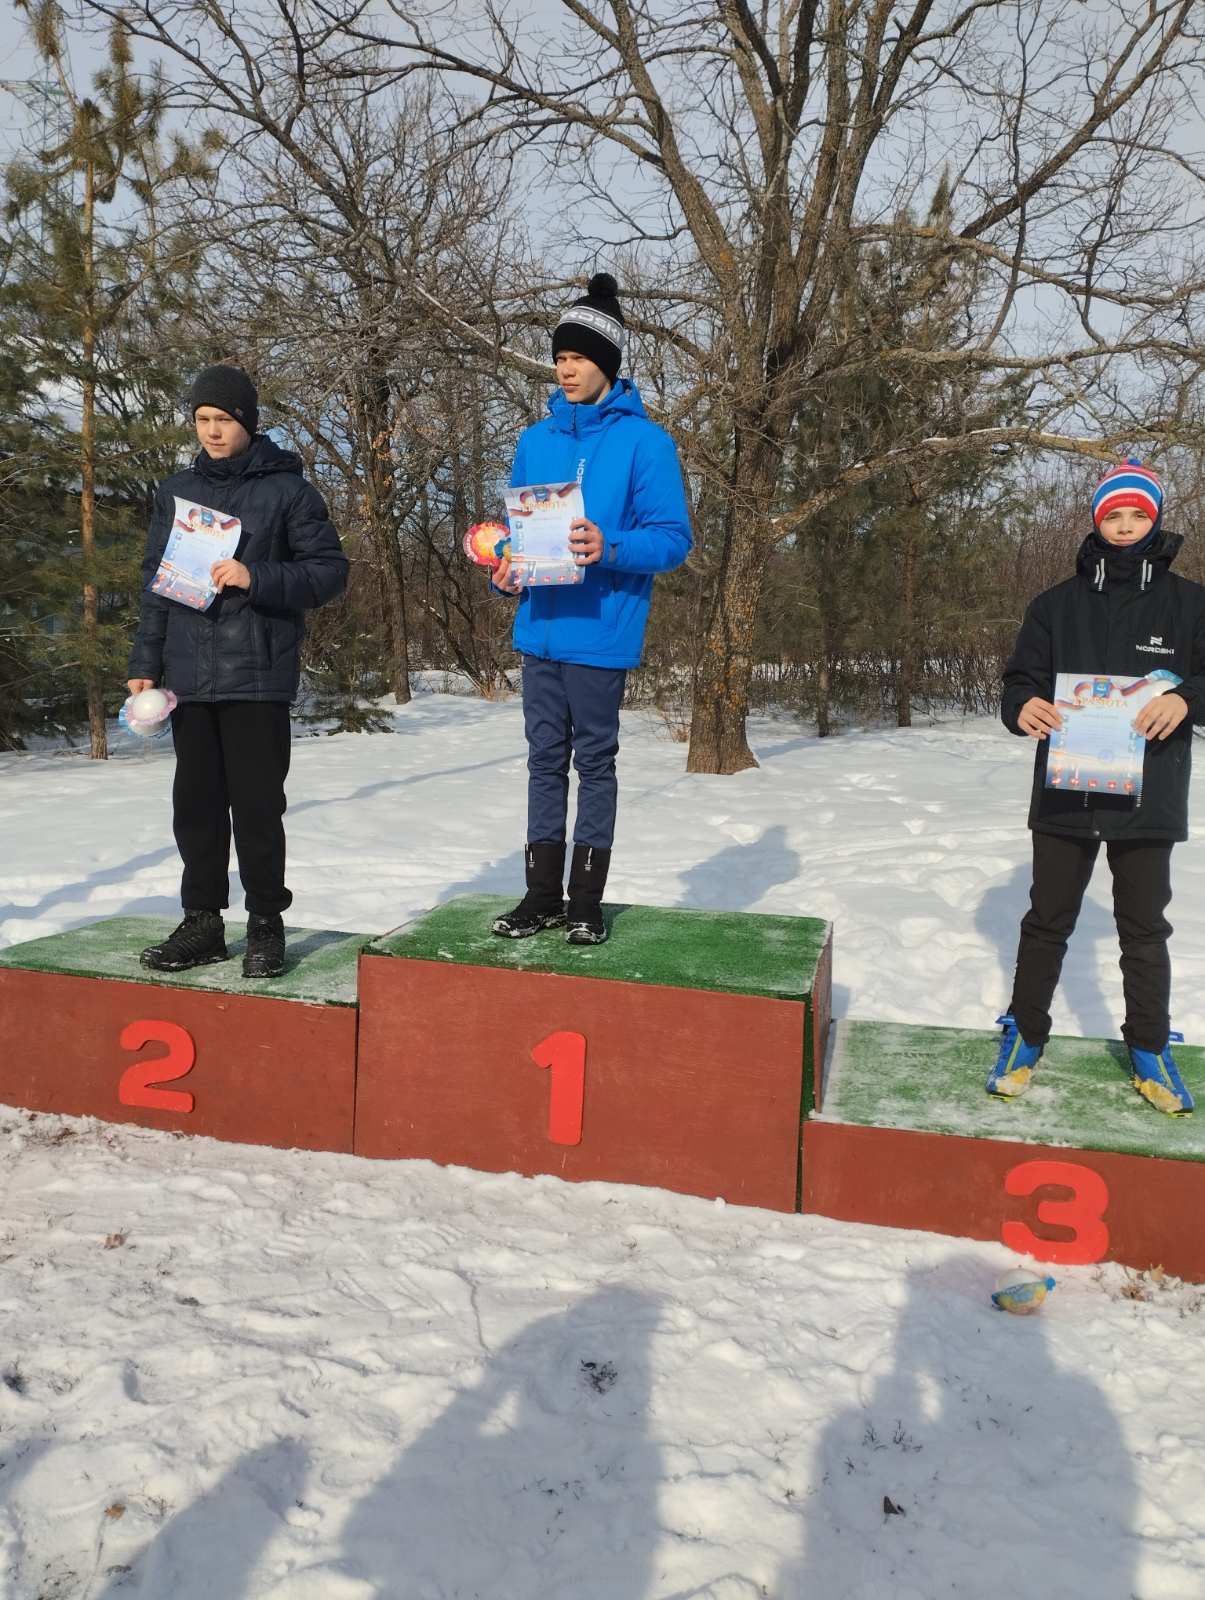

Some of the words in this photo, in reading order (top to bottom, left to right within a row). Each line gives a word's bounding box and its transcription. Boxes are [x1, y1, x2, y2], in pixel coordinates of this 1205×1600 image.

[1135, 644, 1175, 655] NORDSKI
[119, 1020, 195, 1112] 2
[531, 1031, 587, 1145] 1
[1001, 1161, 1109, 1265] 3
